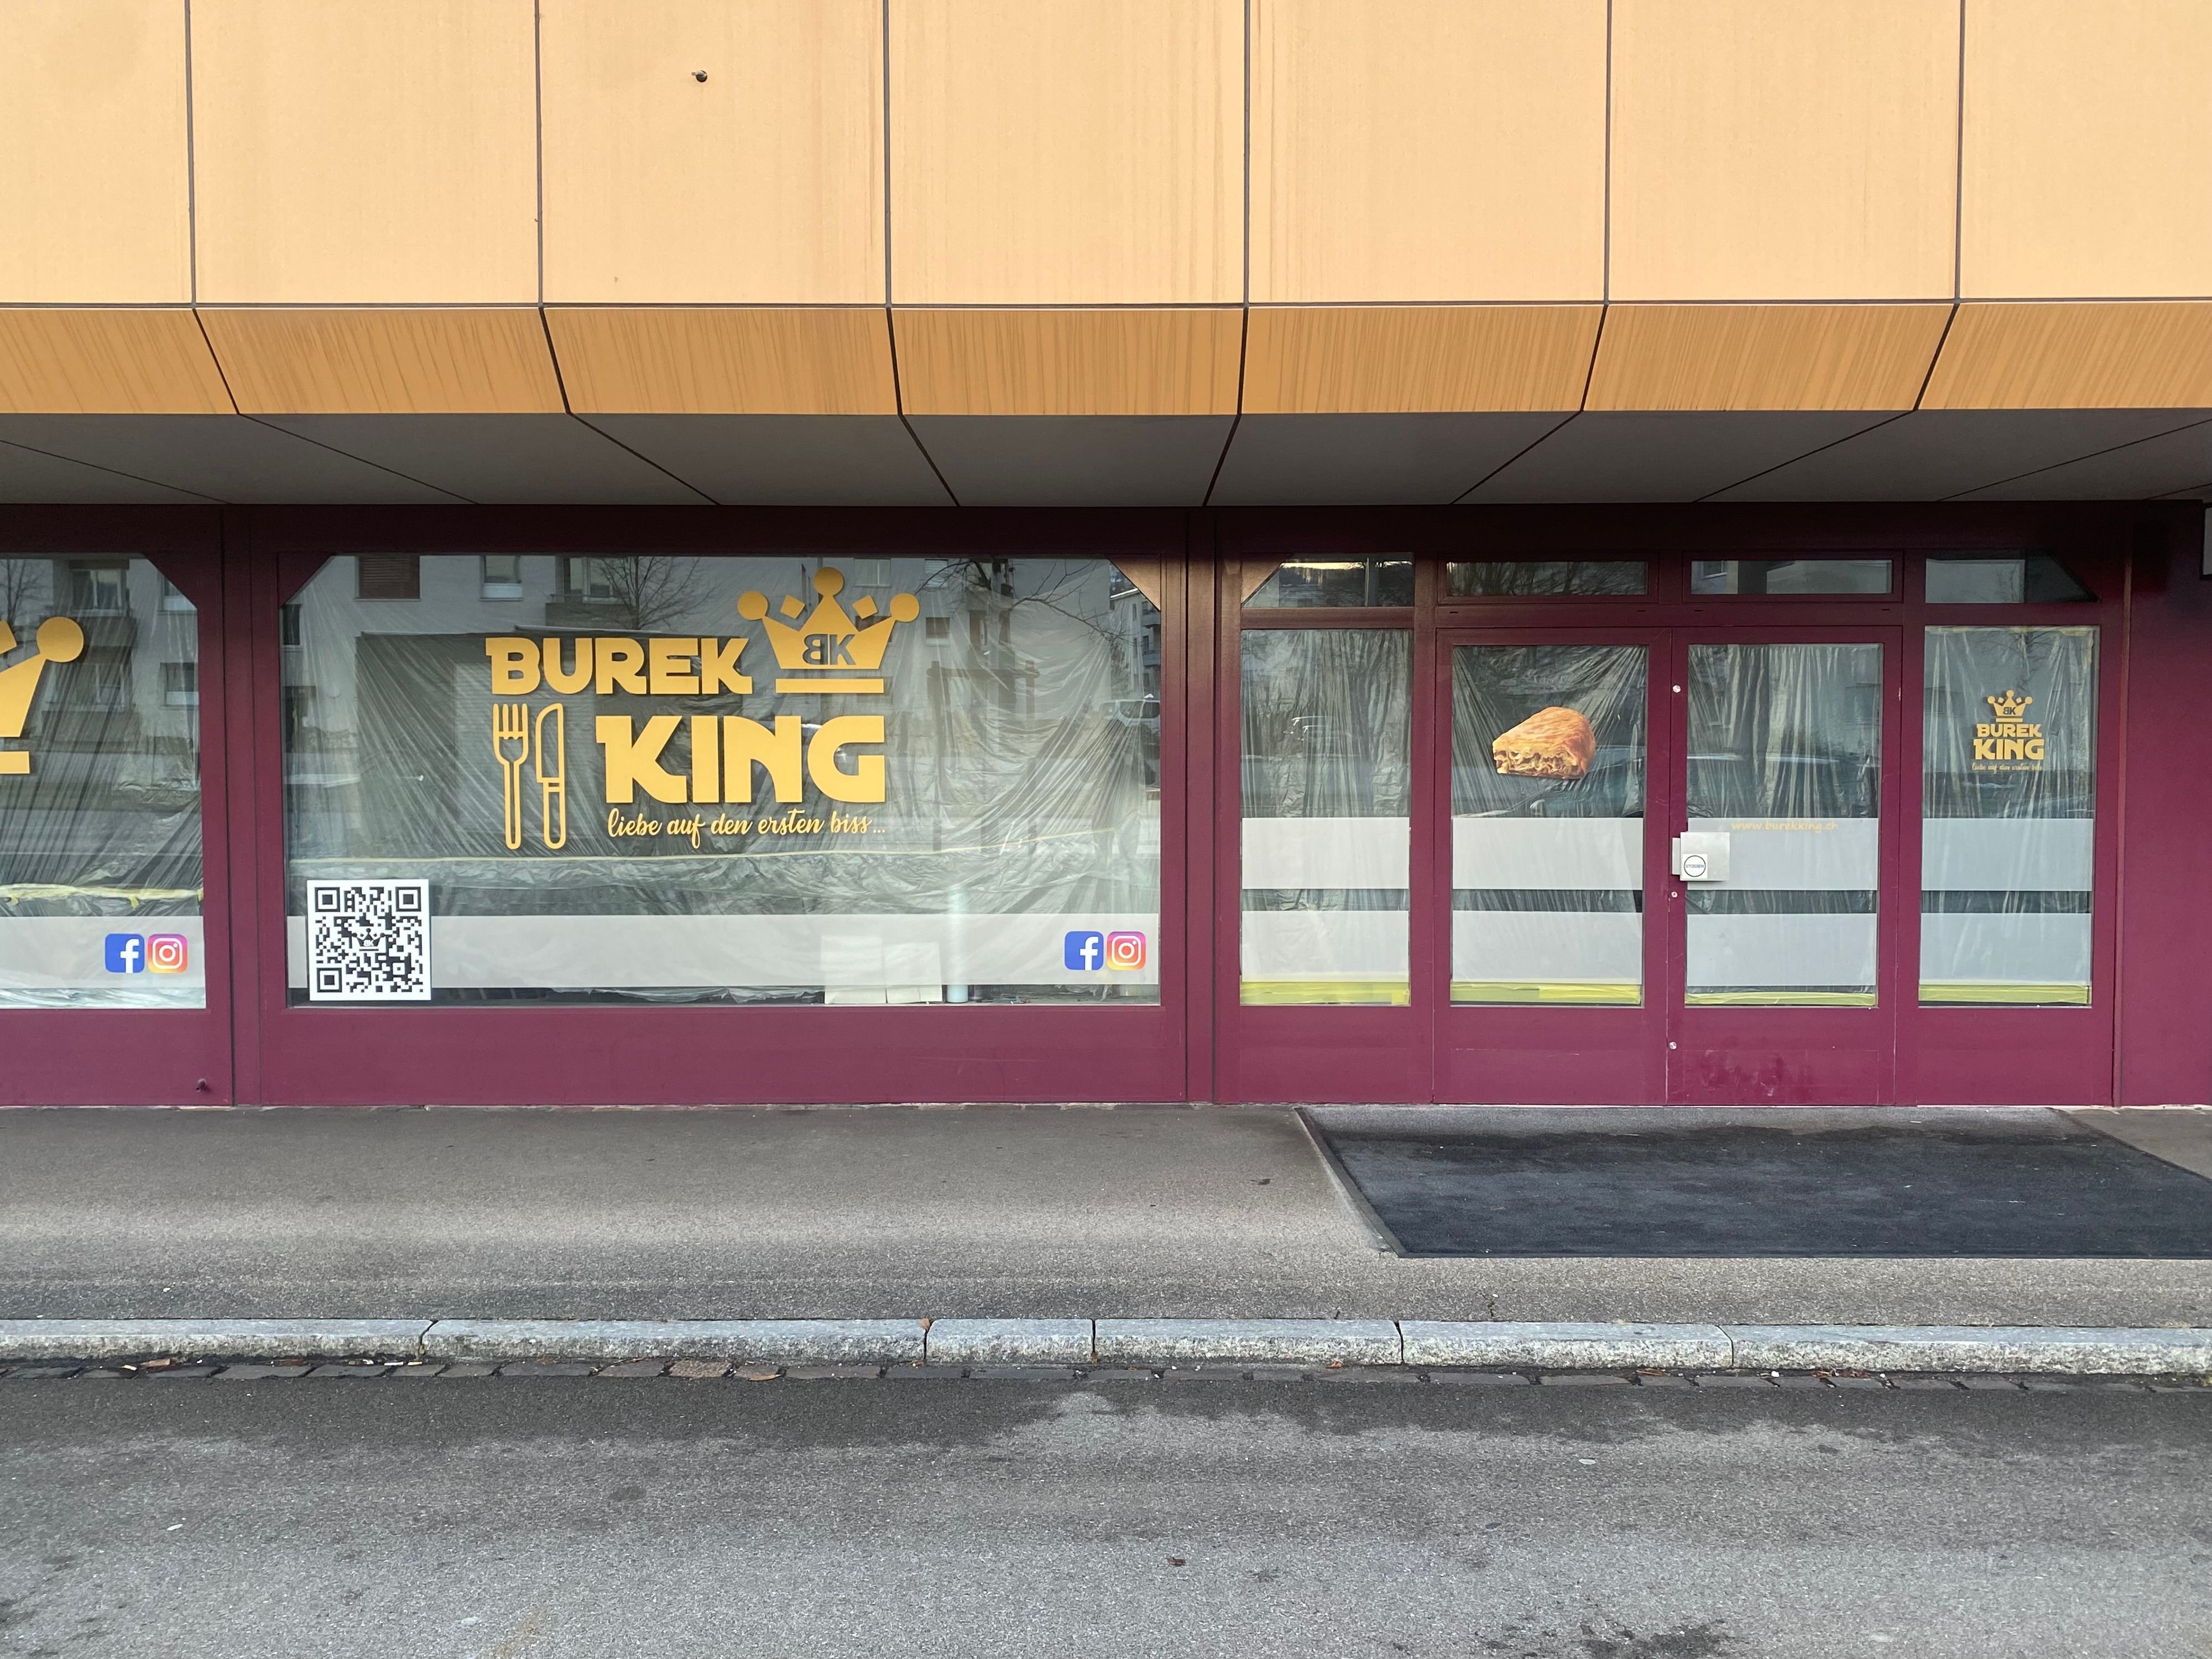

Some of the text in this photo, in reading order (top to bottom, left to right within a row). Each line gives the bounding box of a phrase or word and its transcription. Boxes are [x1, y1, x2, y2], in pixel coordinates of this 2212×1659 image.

[486, 638, 753, 695] BUREK
[1976, 723, 2042, 738] BUREK
[596, 716, 885, 804] KING
[1973, 739, 2044, 760] KING
[608, 808, 662, 837] liebe
[667, 813, 706, 849] auf
[711, 813, 753, 835] den
[758, 808, 825, 836] ersten
[1731, 820, 1838, 833] www.burekking.ch
